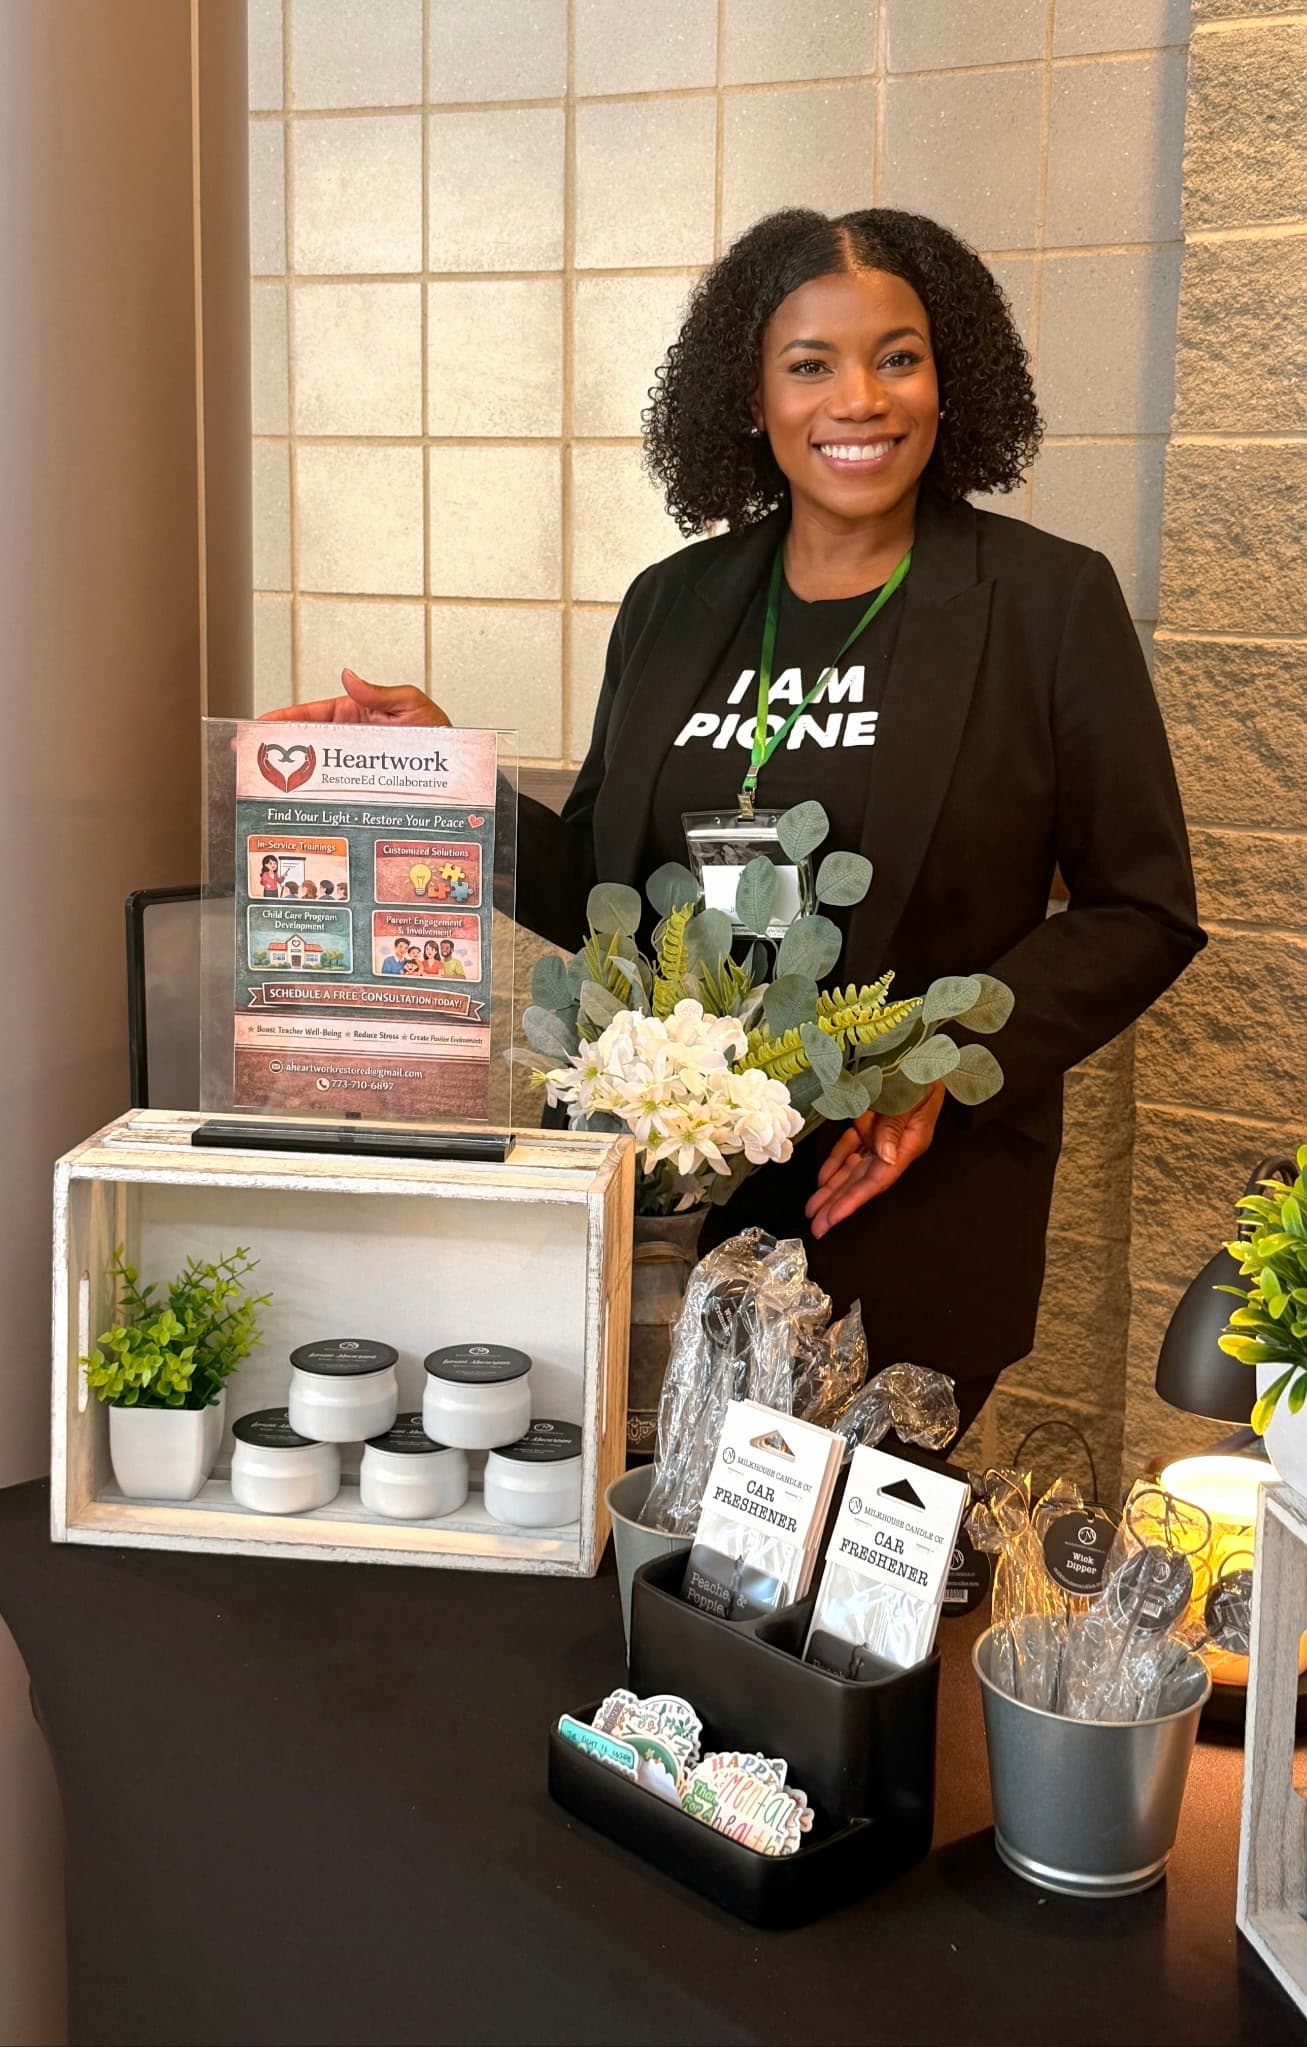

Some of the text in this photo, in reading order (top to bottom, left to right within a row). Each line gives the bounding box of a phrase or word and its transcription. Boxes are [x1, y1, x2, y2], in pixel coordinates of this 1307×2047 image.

[727, 665, 866, 705] I AM
[322, 748, 449, 772] Heartwork
[321, 773, 448, 788] RestoreEd Collaborative
[267, 808, 465, 829] Find Your Light Restore Your Peace
[257, 840, 337, 853] In-Service Trainings
[383, 845, 469, 858] Customized Solutions
[262, 909, 338, 923] Child Care Program
[386, 915, 463, 928] Parent Engagement
[275, 920, 325, 931] Development
[406, 928, 452, 937] Involvement
[269, 989, 463, 1008] SCHEDULE A FREE CONSULTATION TODAY!
[277, 1026, 303, 1035] Teacher
[305, 1027, 342, 1039] Well-Being
[353, 1030, 378, 1040] Reduce
[379, 1031, 399, 1041] Stress
[286, 1062, 423, 1078] aheartworkrestored@gmail.com
[331, 1079, 394, 1091] 773-710-6897
[737, 1456, 776, 1478] MILKHOUSE
[775, 1472, 802, 1489] CANDLE
[746, 1480, 775, 1503] CAR
[713, 1486, 797, 1533] FRESHENER
[864, 1506, 905, 1529] MILKHOUSE
[905, 1523, 934, 1541] CANDLE
[874, 1531, 905, 1555] CAR
[839, 1537, 929, 1587] FRESHENER
[1072, 1551, 1094, 1565] Wick
[1066, 1560, 1097, 1575] Dipper
[736, 1593, 748, 1609] &
